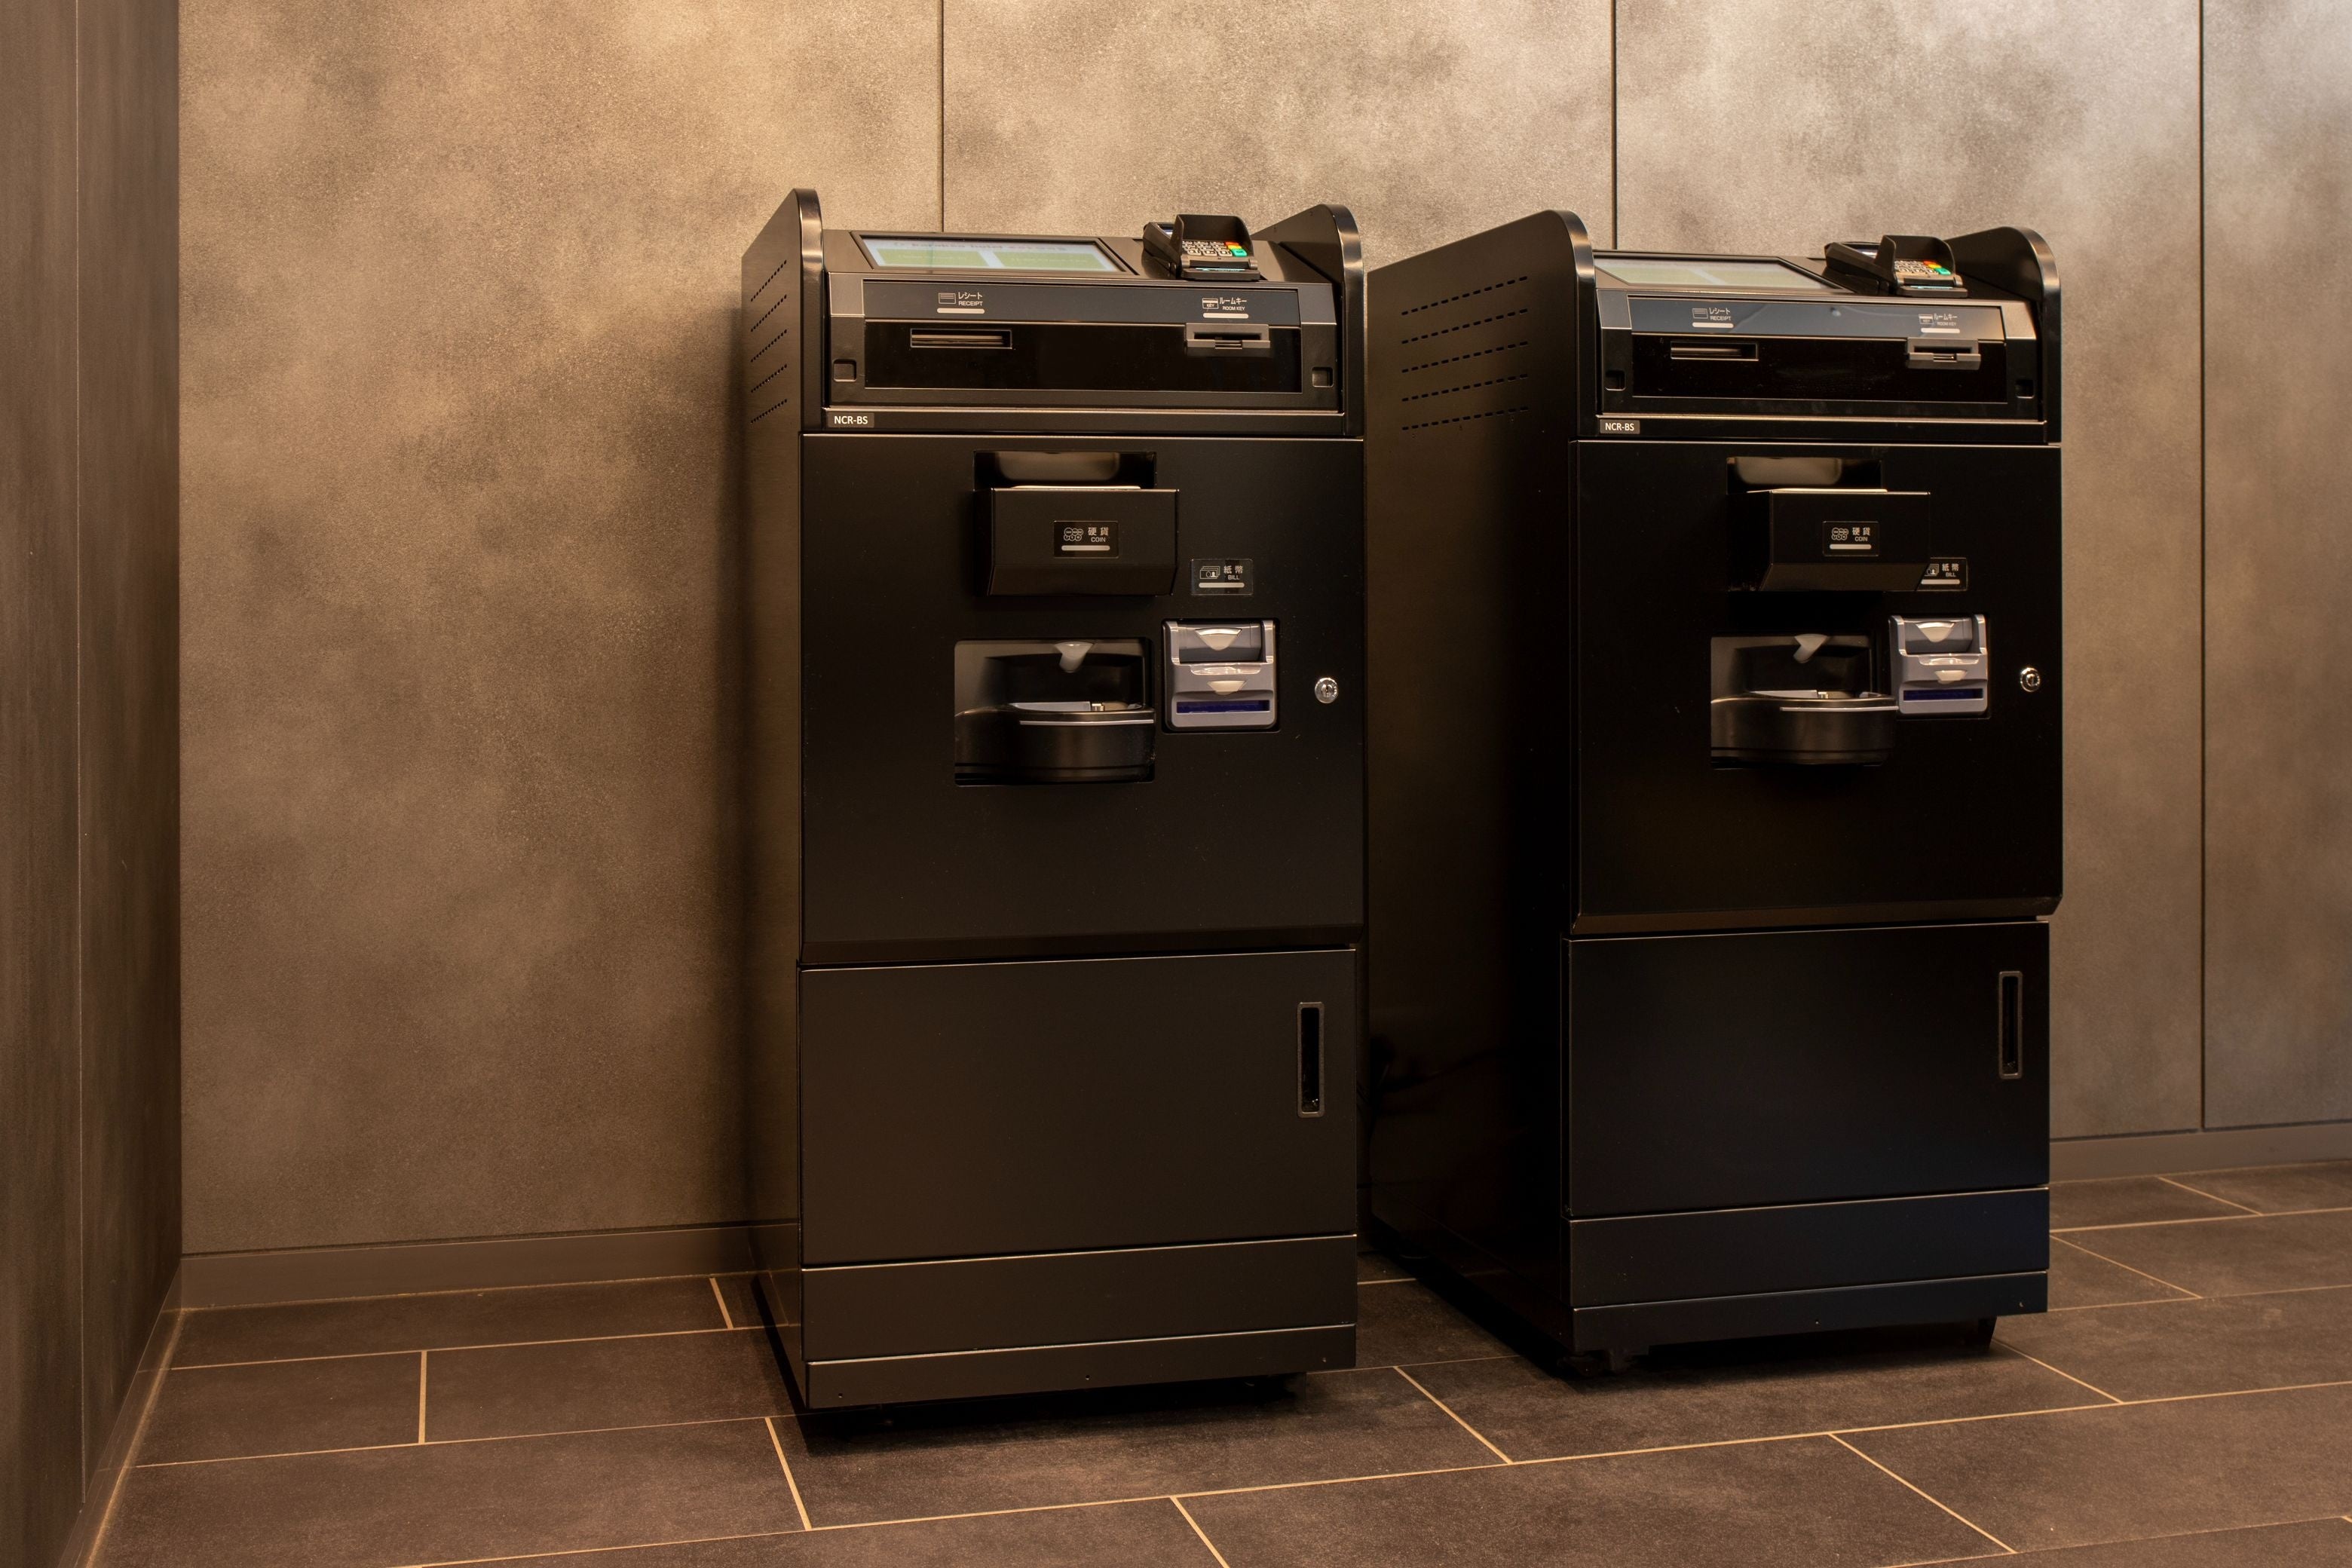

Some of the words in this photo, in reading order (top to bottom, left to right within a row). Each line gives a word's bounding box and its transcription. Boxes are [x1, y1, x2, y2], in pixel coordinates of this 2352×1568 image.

[958, 292, 983, 300] レシート
[834, 415, 868, 424] NCR-BS
[1605, 422, 1634, 431] NCR-BS
